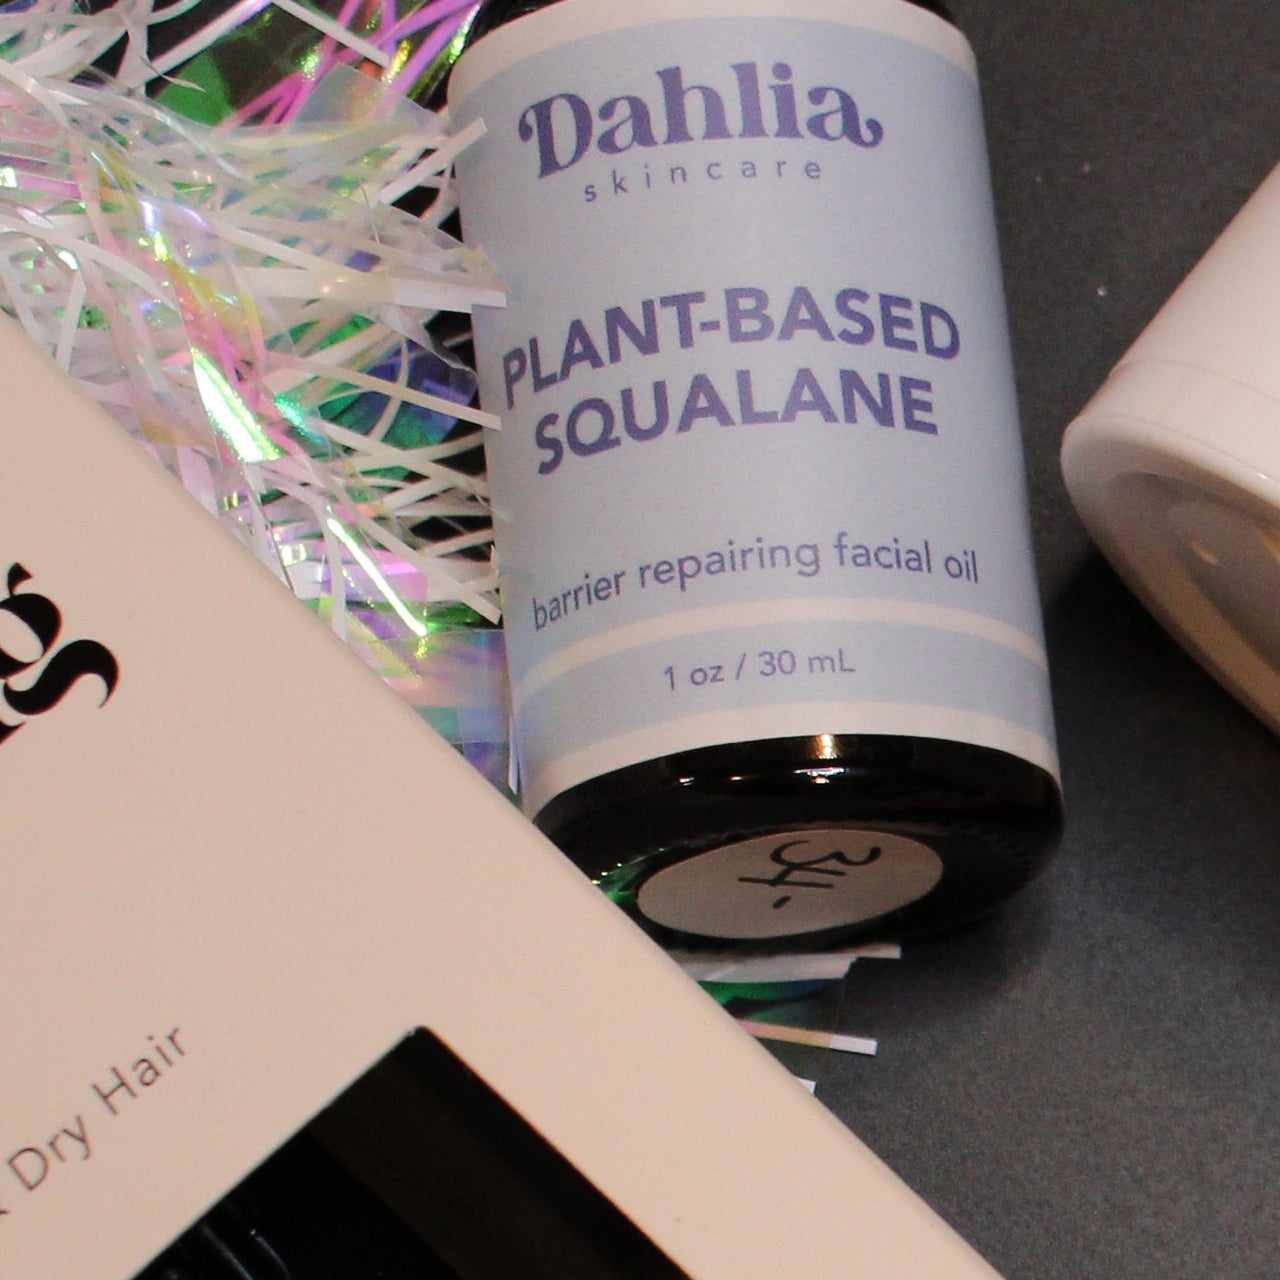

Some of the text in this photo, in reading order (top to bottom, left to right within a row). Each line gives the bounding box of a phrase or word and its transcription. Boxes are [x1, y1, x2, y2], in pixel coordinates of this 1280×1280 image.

[518, 62, 884, 178] Dahlia
[584, 157, 822, 201] skincare
[503, 286, 960, 409] PLANT-BASED
[535, 369, 938, 475] SQUALANE
[533, 532, 979, 631] barrier repairing facial oil
[664, 667, 677, 691] 1
[690, 663, 725, 686] oz
[758, 650, 796, 677] 30
[807, 649, 856, 674] mL
[7, 1027, 186, 1191] Dry Hair
